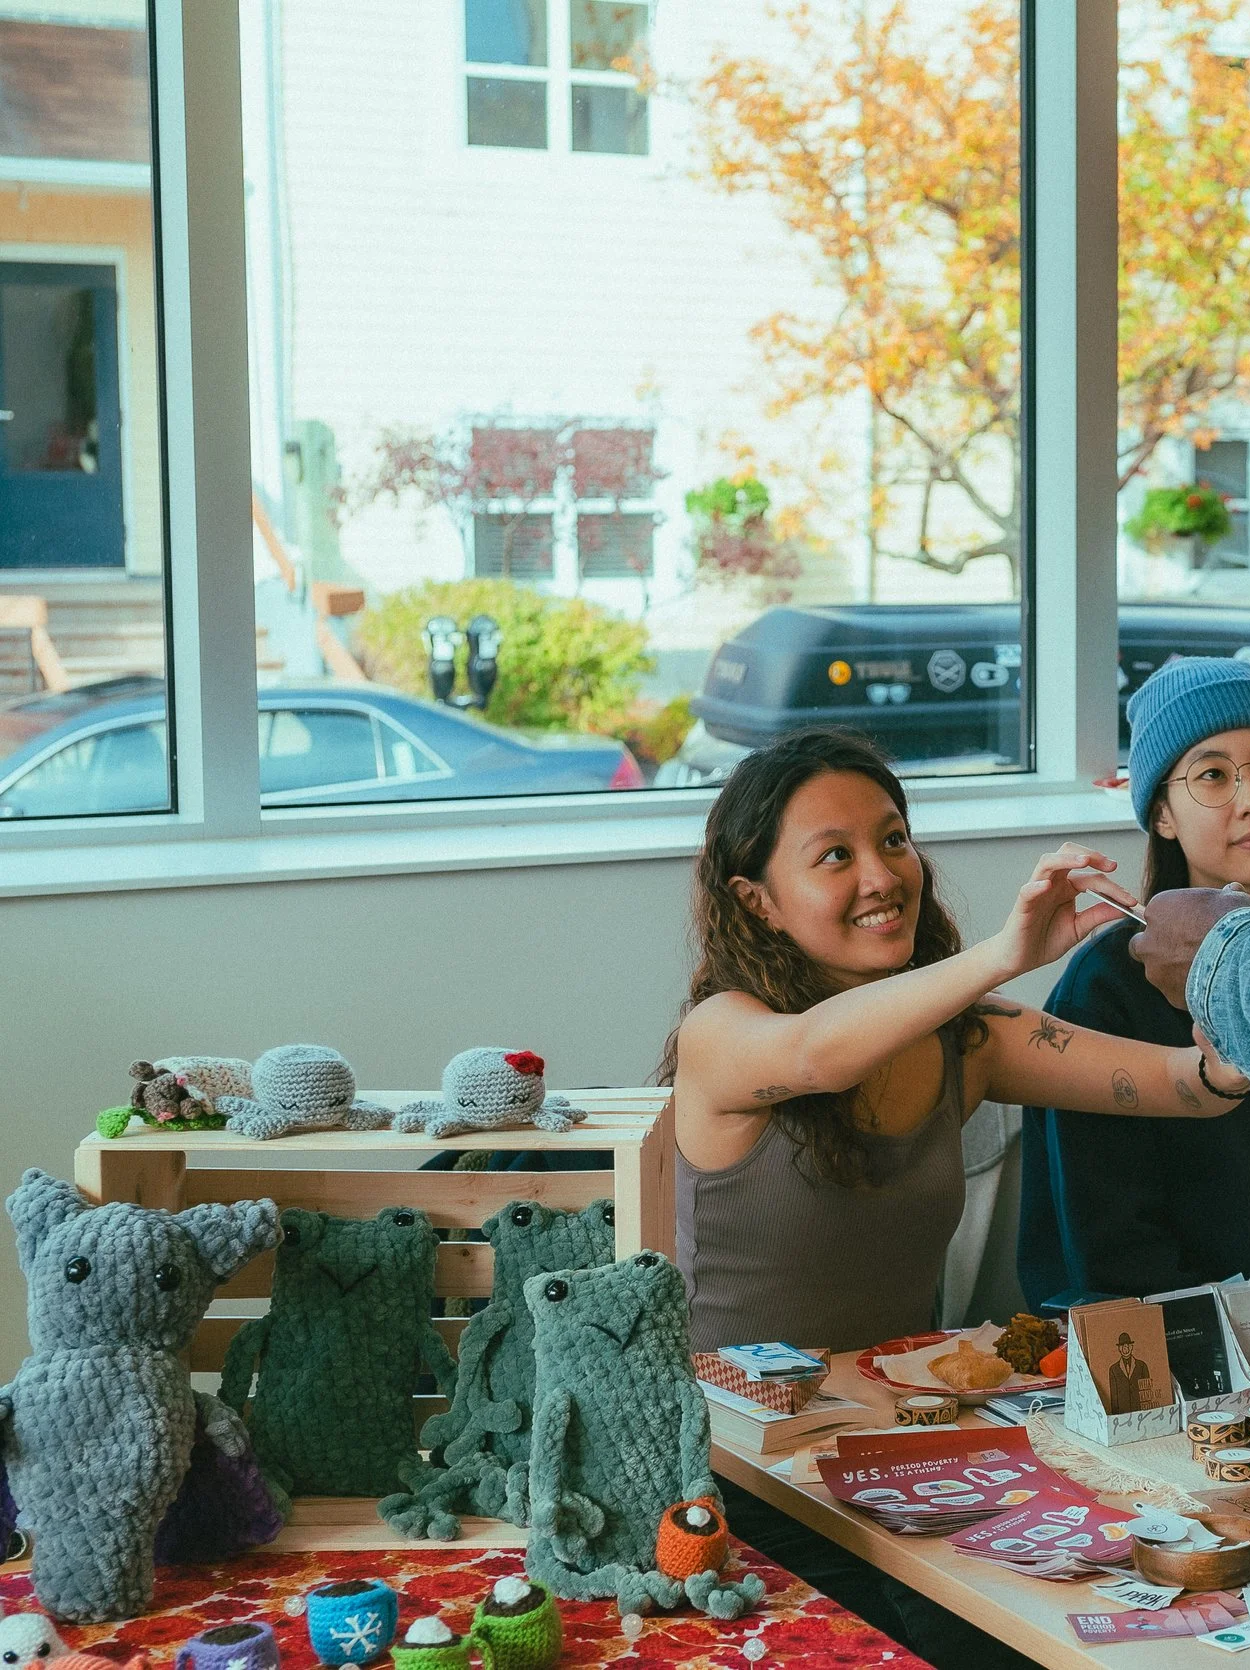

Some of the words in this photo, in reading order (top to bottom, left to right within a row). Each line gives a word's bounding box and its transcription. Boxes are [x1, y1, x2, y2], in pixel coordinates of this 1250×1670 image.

[890, 1463, 920, 1472] PERIOD
[922, 1457, 958, 1467] POVERTY
[843, 1467, 888, 1484] YES.
[965, 1529, 997, 1543] YES.
[1076, 1616, 1113, 1625] END
[1080, 1623, 1116, 1631] PERIOD
